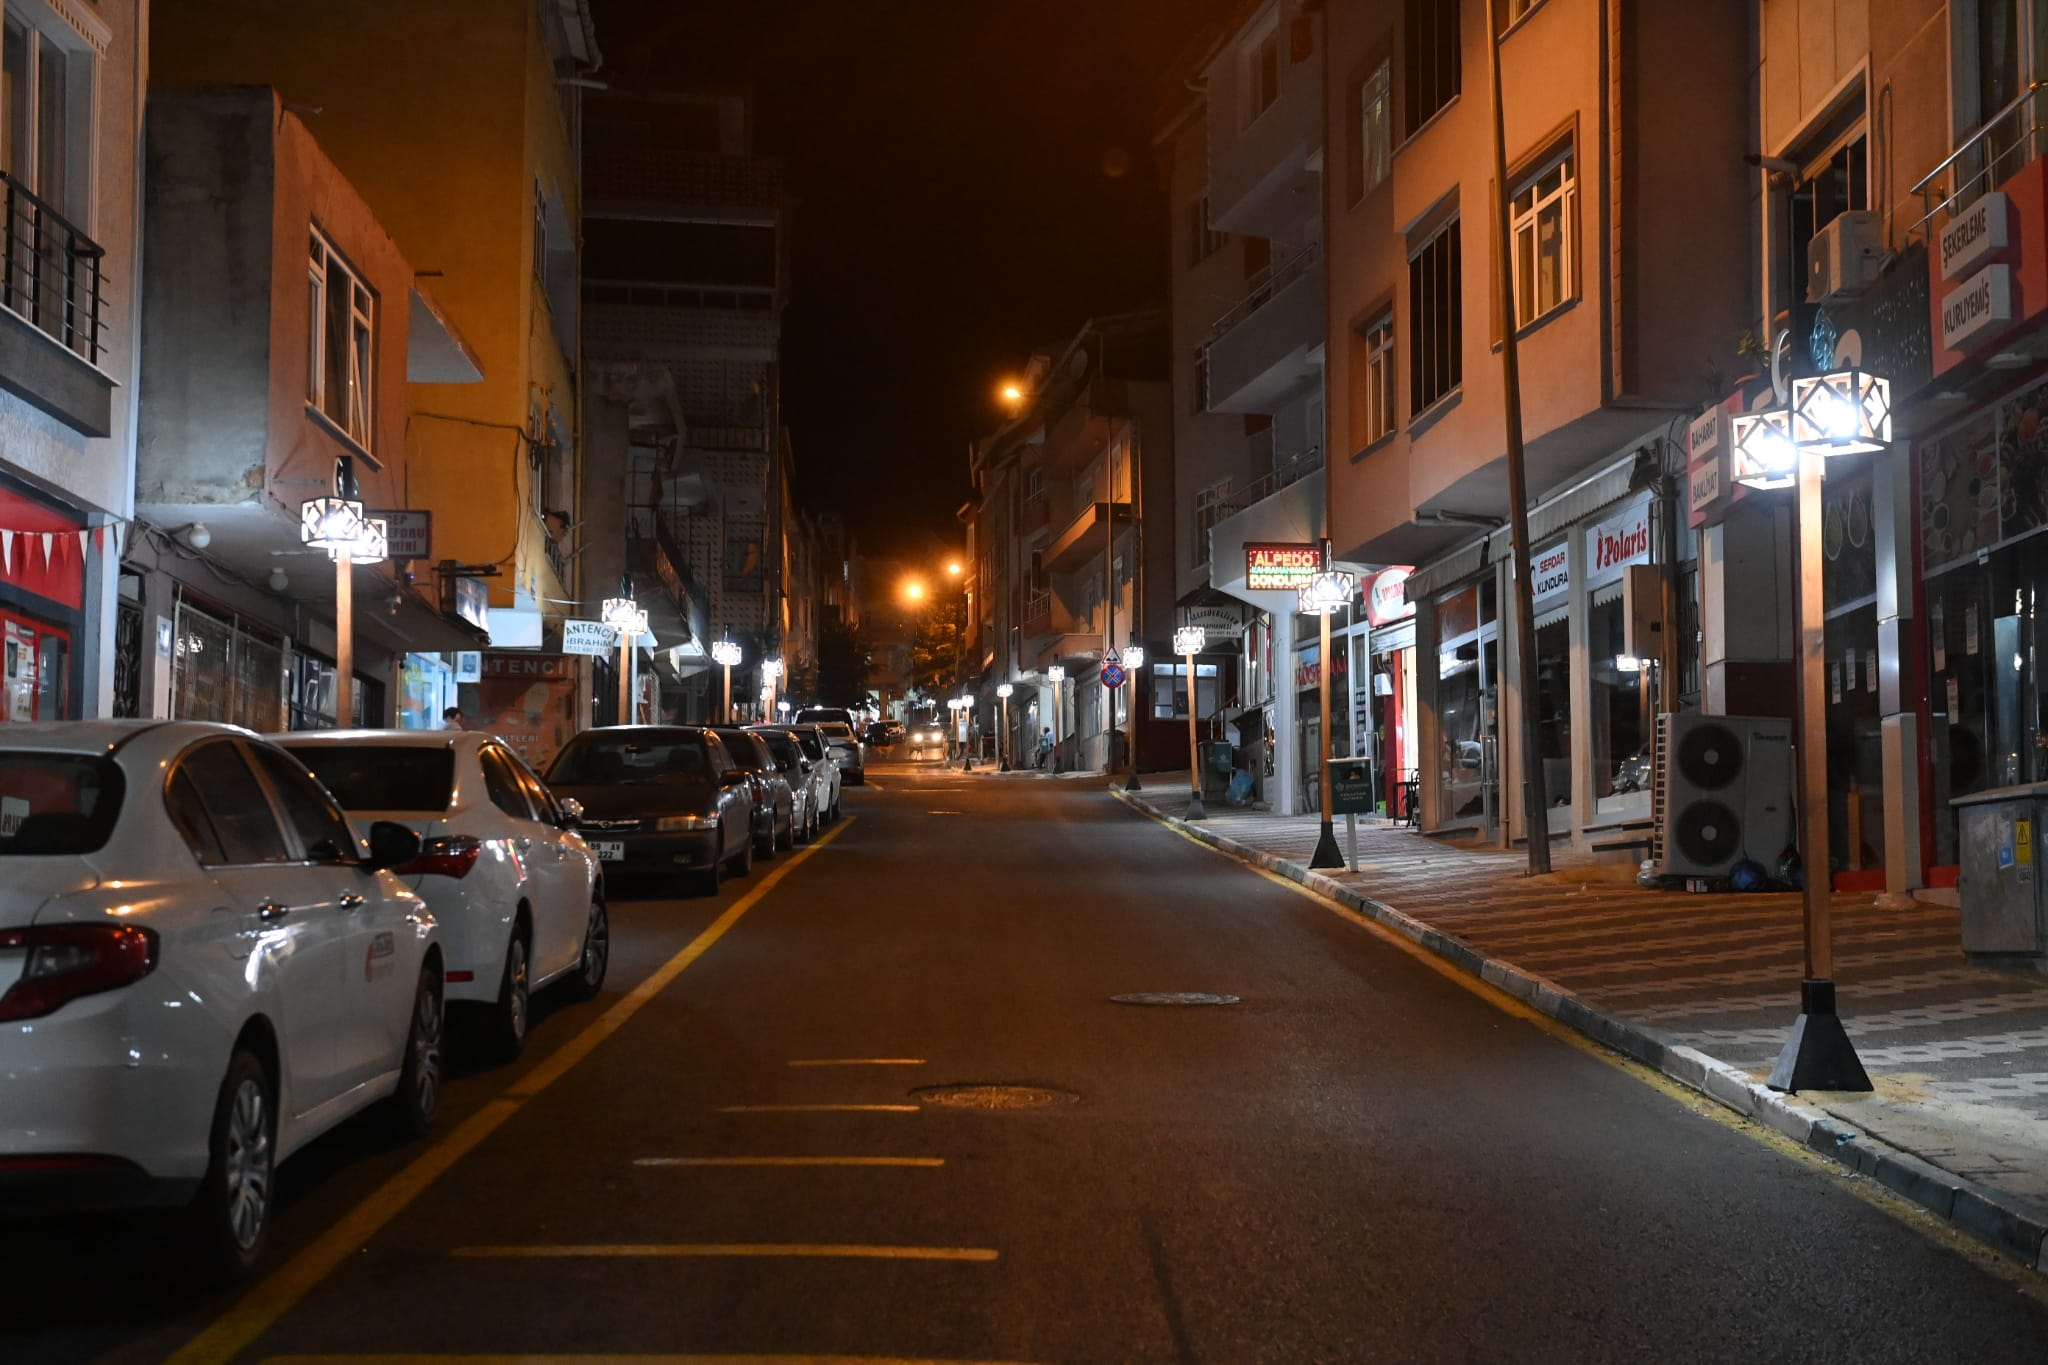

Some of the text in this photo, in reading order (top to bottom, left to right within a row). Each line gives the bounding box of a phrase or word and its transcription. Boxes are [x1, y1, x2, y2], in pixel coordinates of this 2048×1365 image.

[1943, 207, 1986, 269] ŞEKERLEME
[1944, 278, 1989, 335] KURUYEMİŞ
[1692, 417, 1716, 449] BAHARAT
[1693, 472, 1717, 504] BAKLİYAT
[1254, 552, 1314, 567] ALPEDO
[1604, 522, 1646, 567] Polaris
[1540, 552, 1565, 573] SERDAR
[1249, 574, 1312, 586] DONDURM
[1537, 571, 1568, 594] KUNDURA
